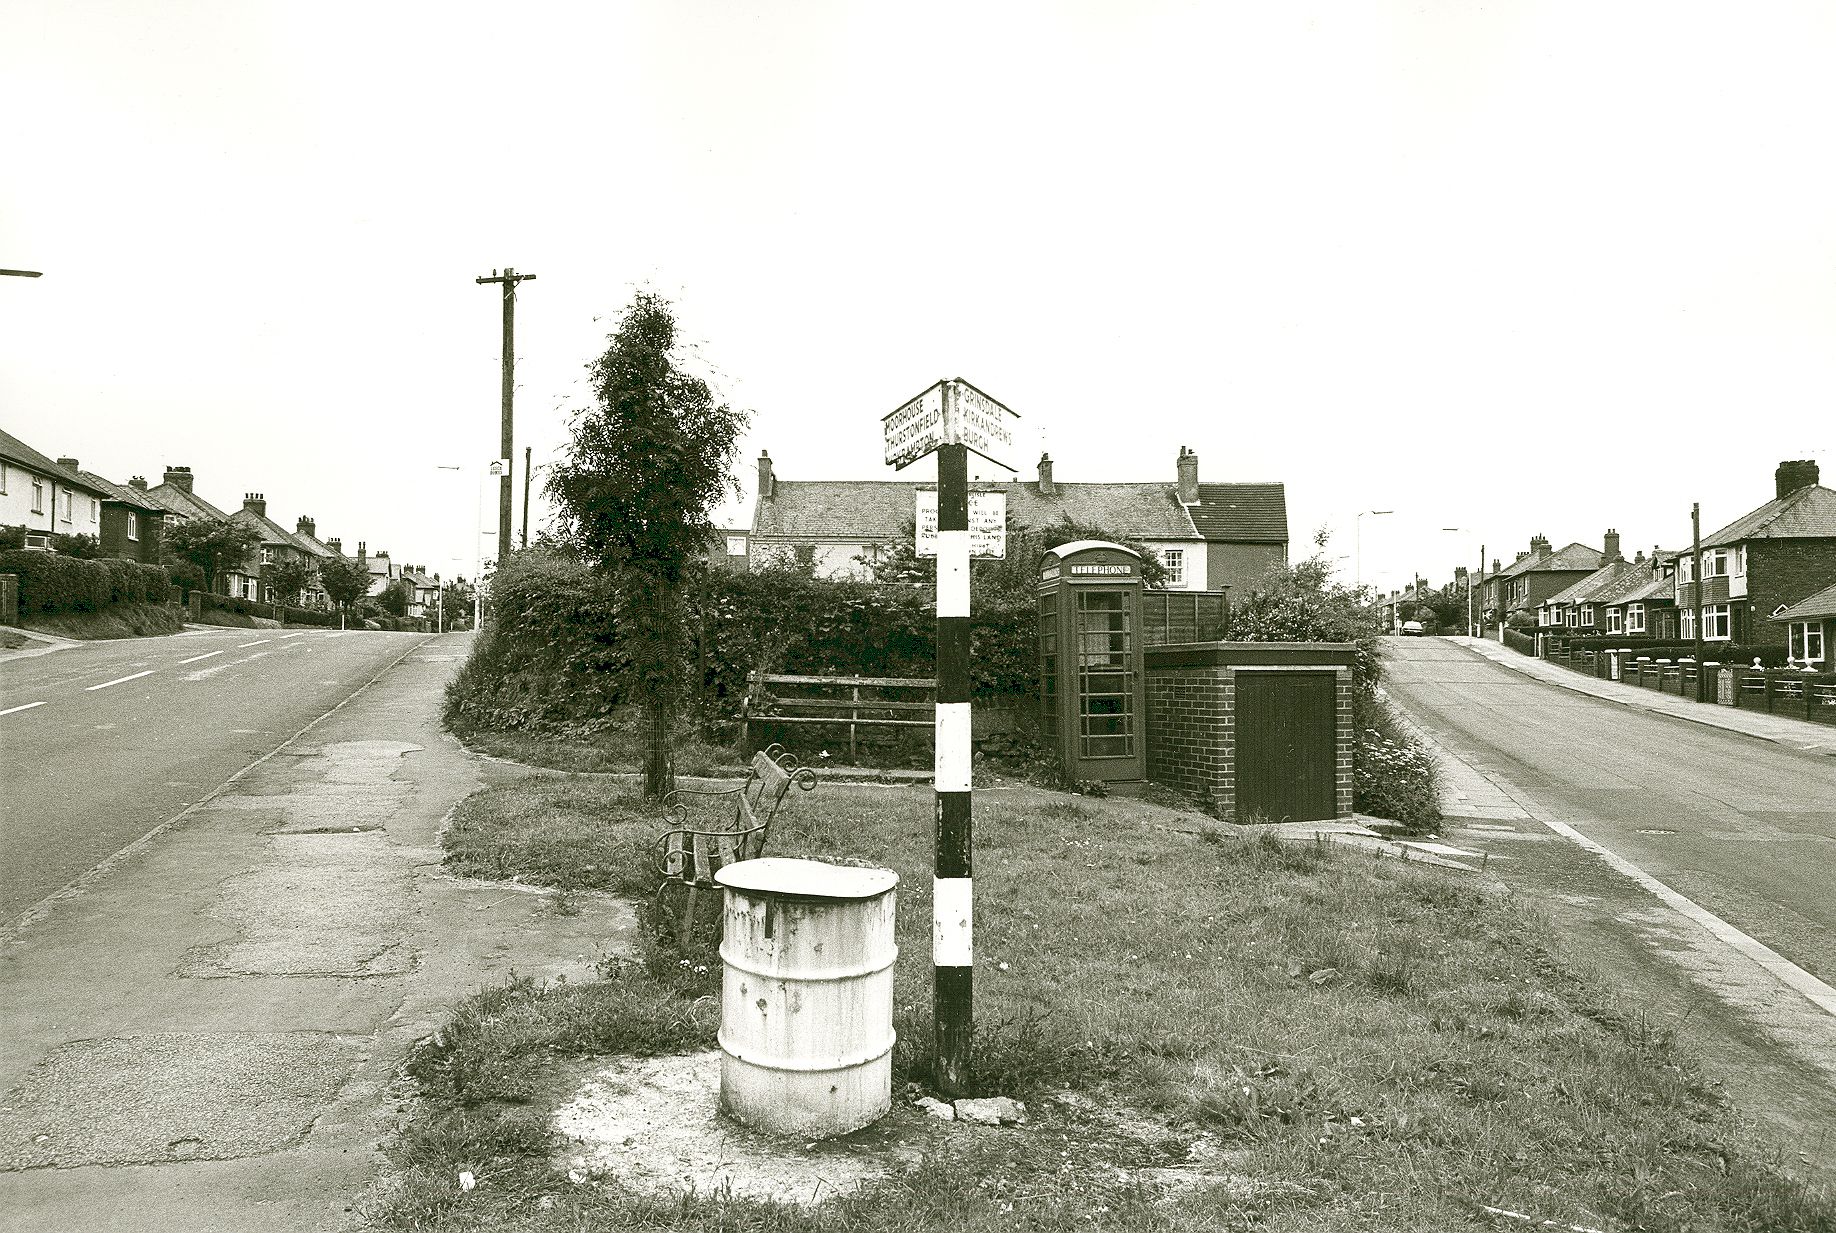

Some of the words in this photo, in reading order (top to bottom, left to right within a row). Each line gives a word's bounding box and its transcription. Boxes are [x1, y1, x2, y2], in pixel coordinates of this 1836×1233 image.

[884, 398, 924, 436] MOORHOUSE
[964, 388, 1003, 423] GRINSDALE
[885, 408, 939, 452] THURSTONFIELD
[963, 406, 1013, 447] KIRKANDREWS
[1071, 565, 1131, 574] TELEPHONE
